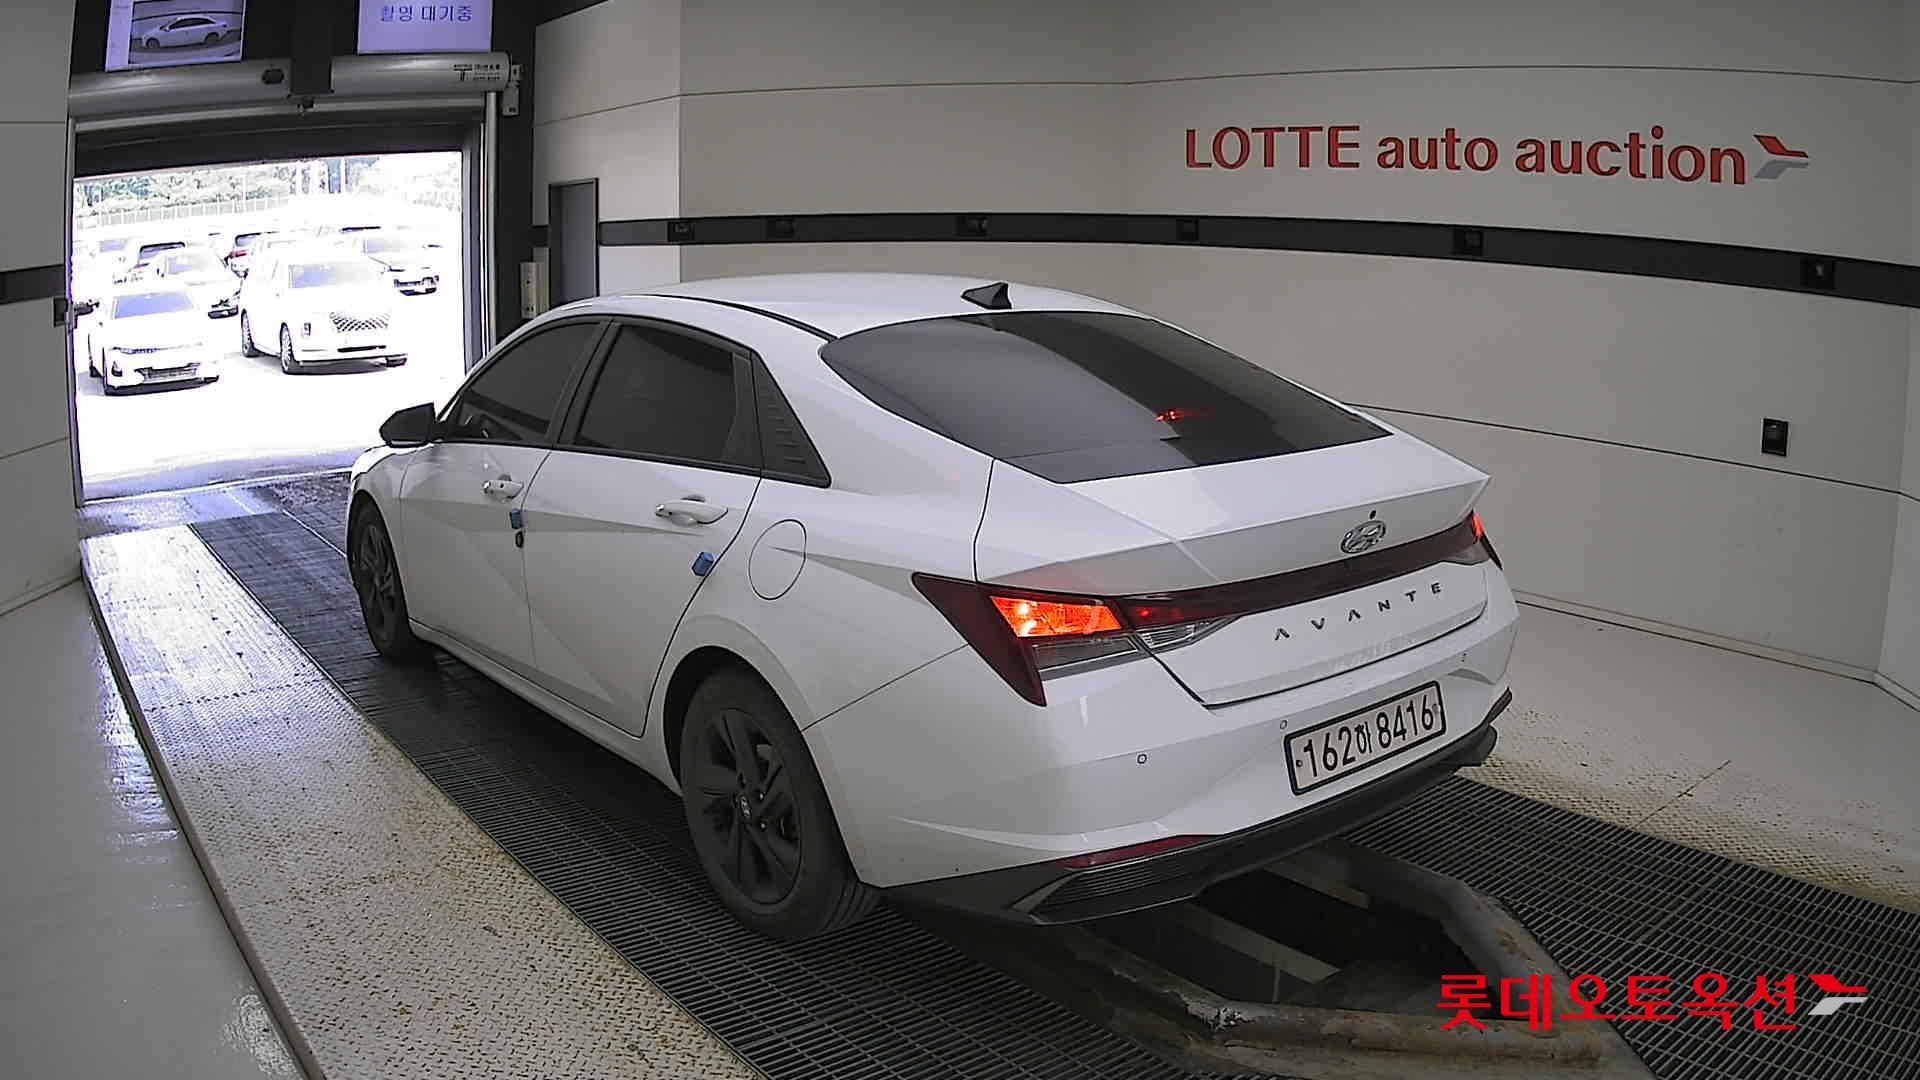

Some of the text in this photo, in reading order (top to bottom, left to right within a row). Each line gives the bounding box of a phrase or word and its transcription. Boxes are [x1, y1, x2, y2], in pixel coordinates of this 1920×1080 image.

[421, 5, 472, 22] 대기중
[1185, 125, 1746, 184] LOTTE auto auction
[1274, 582, 1442, 641] AVANTE
[1376, 694, 1434, 749] 8416
